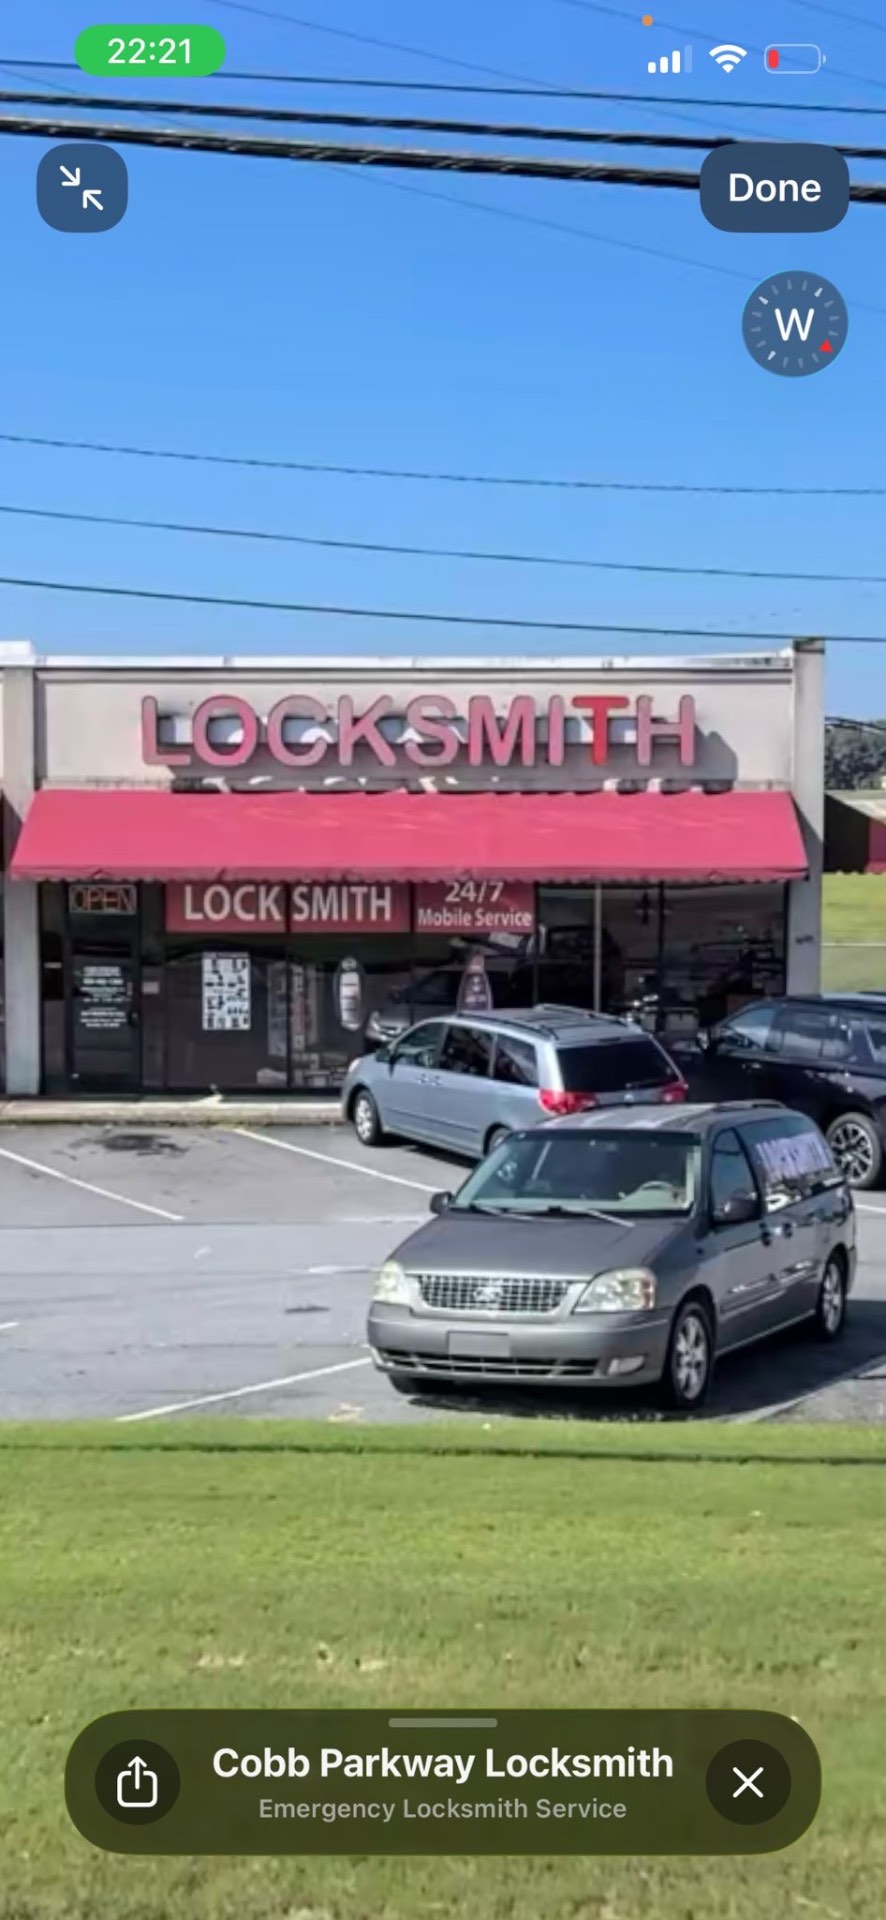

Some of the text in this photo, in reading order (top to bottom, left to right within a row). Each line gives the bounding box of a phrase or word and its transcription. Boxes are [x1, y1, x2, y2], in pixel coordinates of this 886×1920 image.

[141, 694, 696, 767] LOCKSMITH
[72, 887, 136, 912] OPEN
[184, 884, 392, 922] LOCK SMITH
[445, 881, 503, 902] 24/7
[417, 908, 532, 927] Mobile Service
